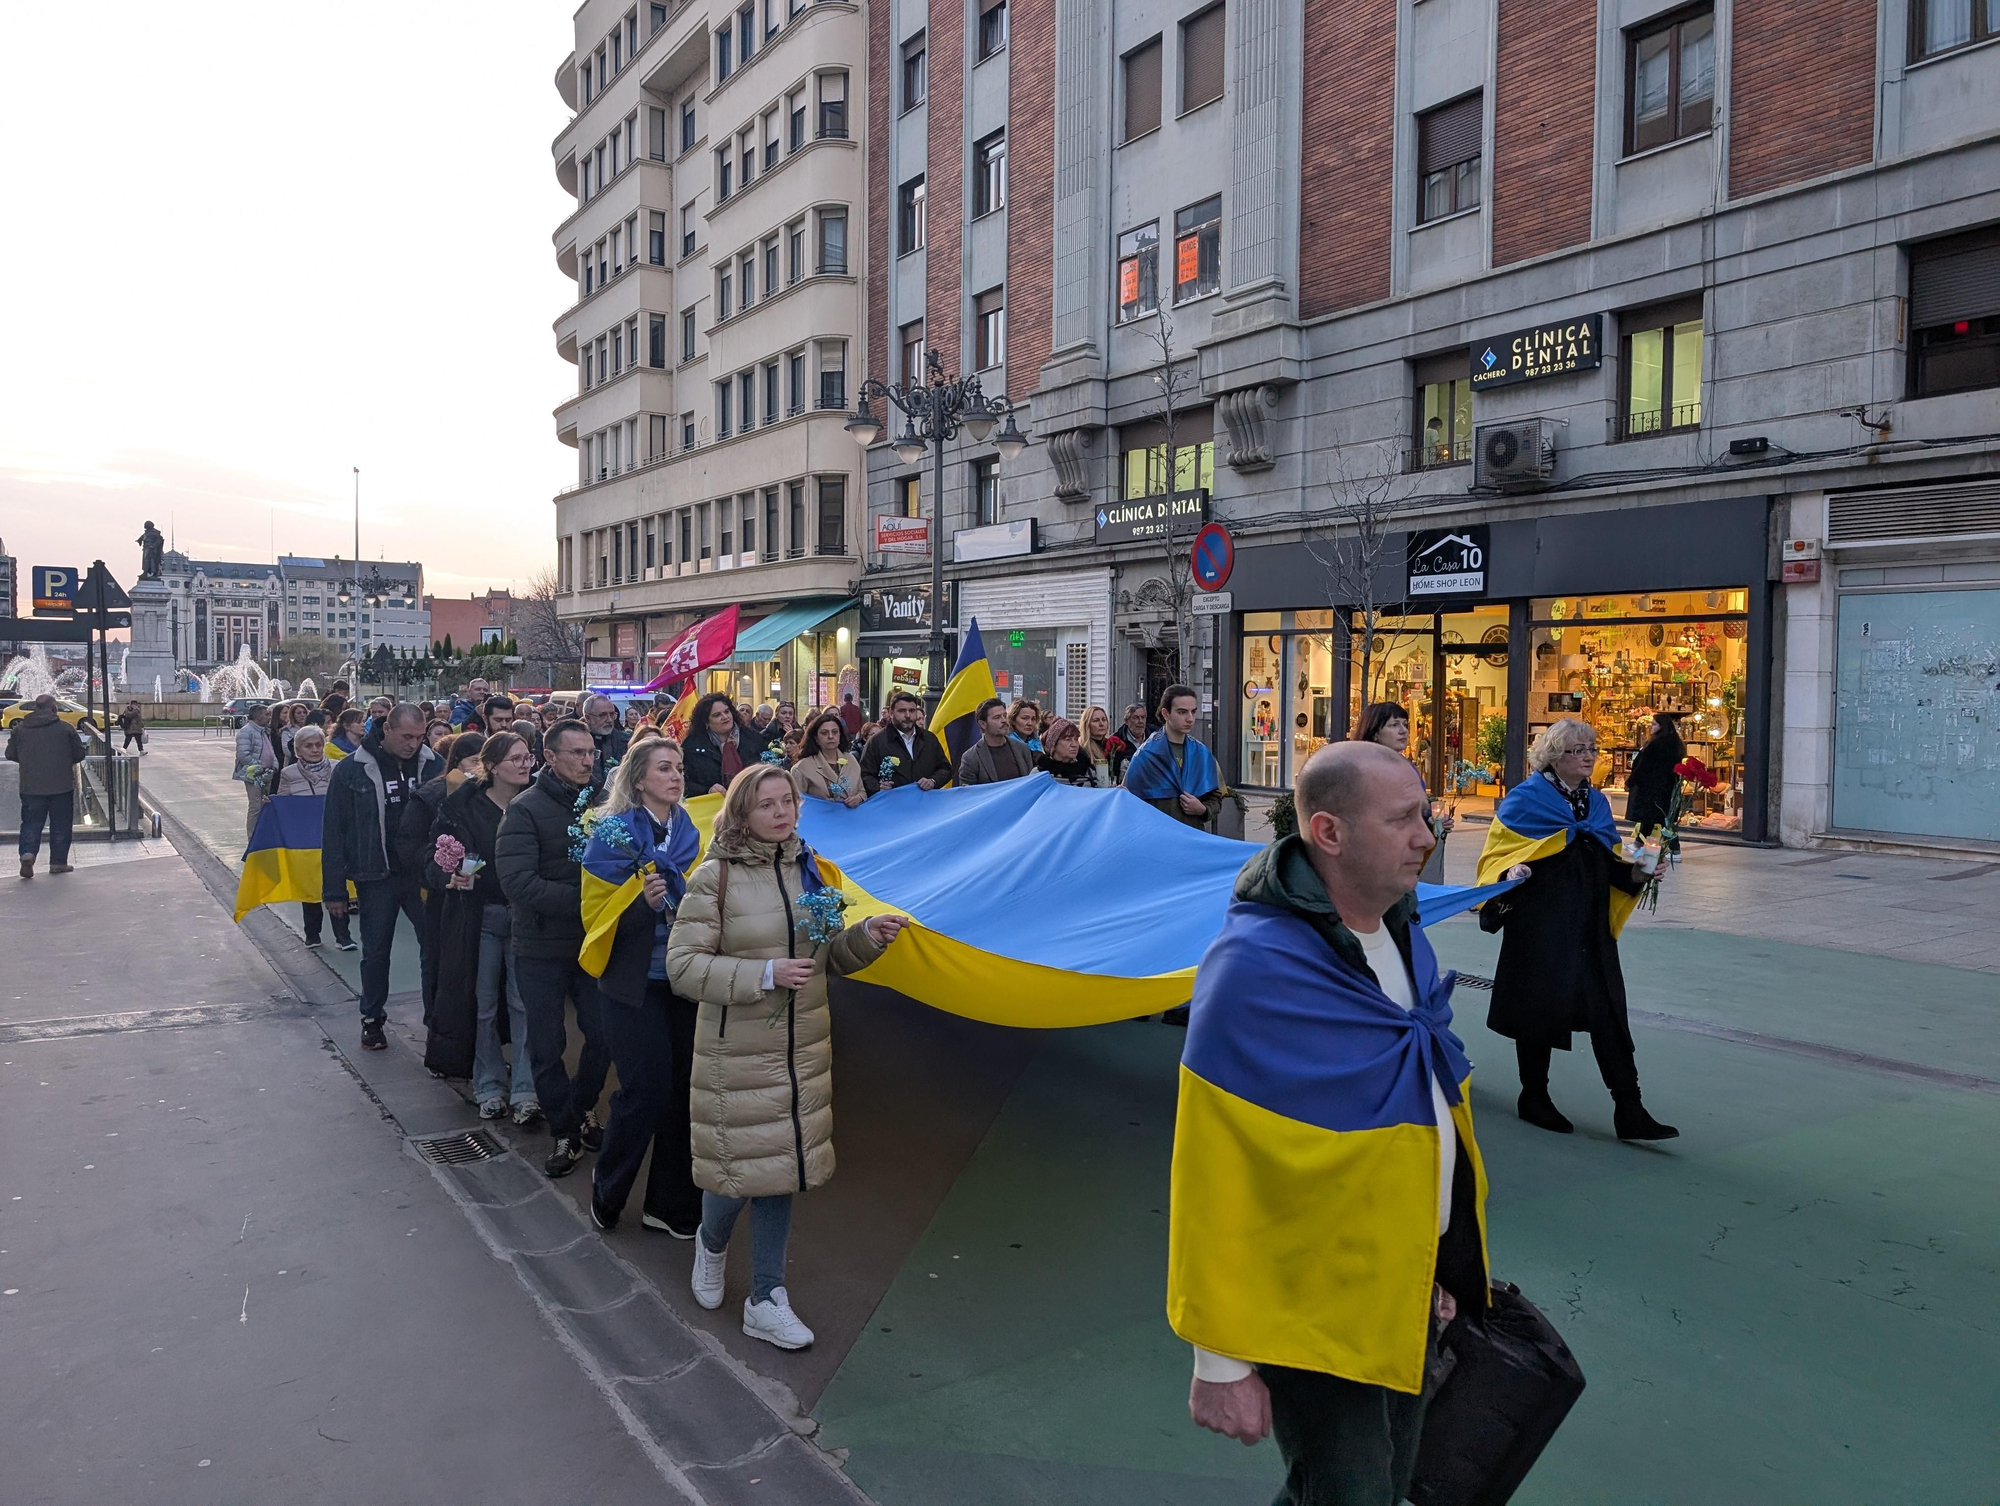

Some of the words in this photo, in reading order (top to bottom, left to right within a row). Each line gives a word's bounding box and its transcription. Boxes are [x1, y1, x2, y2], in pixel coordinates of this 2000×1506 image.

[1512, 323, 1590, 353] CLÍNICA
[1512, 340, 1590, 370] DENTAL
[1473, 368, 1506, 382] CACHERO
[1525, 367, 1539, 377] 987
[1541, 365, 1551, 374] 23
[1553, 363, 1563, 371] 23
[1565, 360, 1576, 369] 36
[1109, 505, 1153, 524] CLÍNICA
[882, 518, 903, 531] AQUÍ
[1145, 525, 1154, 534] 23
[1413, 558, 1429, 574] La
[1433, 556, 1460, 573] Casa
[1461, 548, 1482, 569] 10
[45, 570, 67, 596] P
[1412, 580, 1435, 590] HOME
[1436, 579, 1458, 588] SHOP
[1460, 577, 1481, 587] LEON
[882, 594, 925, 624] Vanity
[889, 646, 902, 656] Vanity
[893, 675, 918, 684] rebajas
